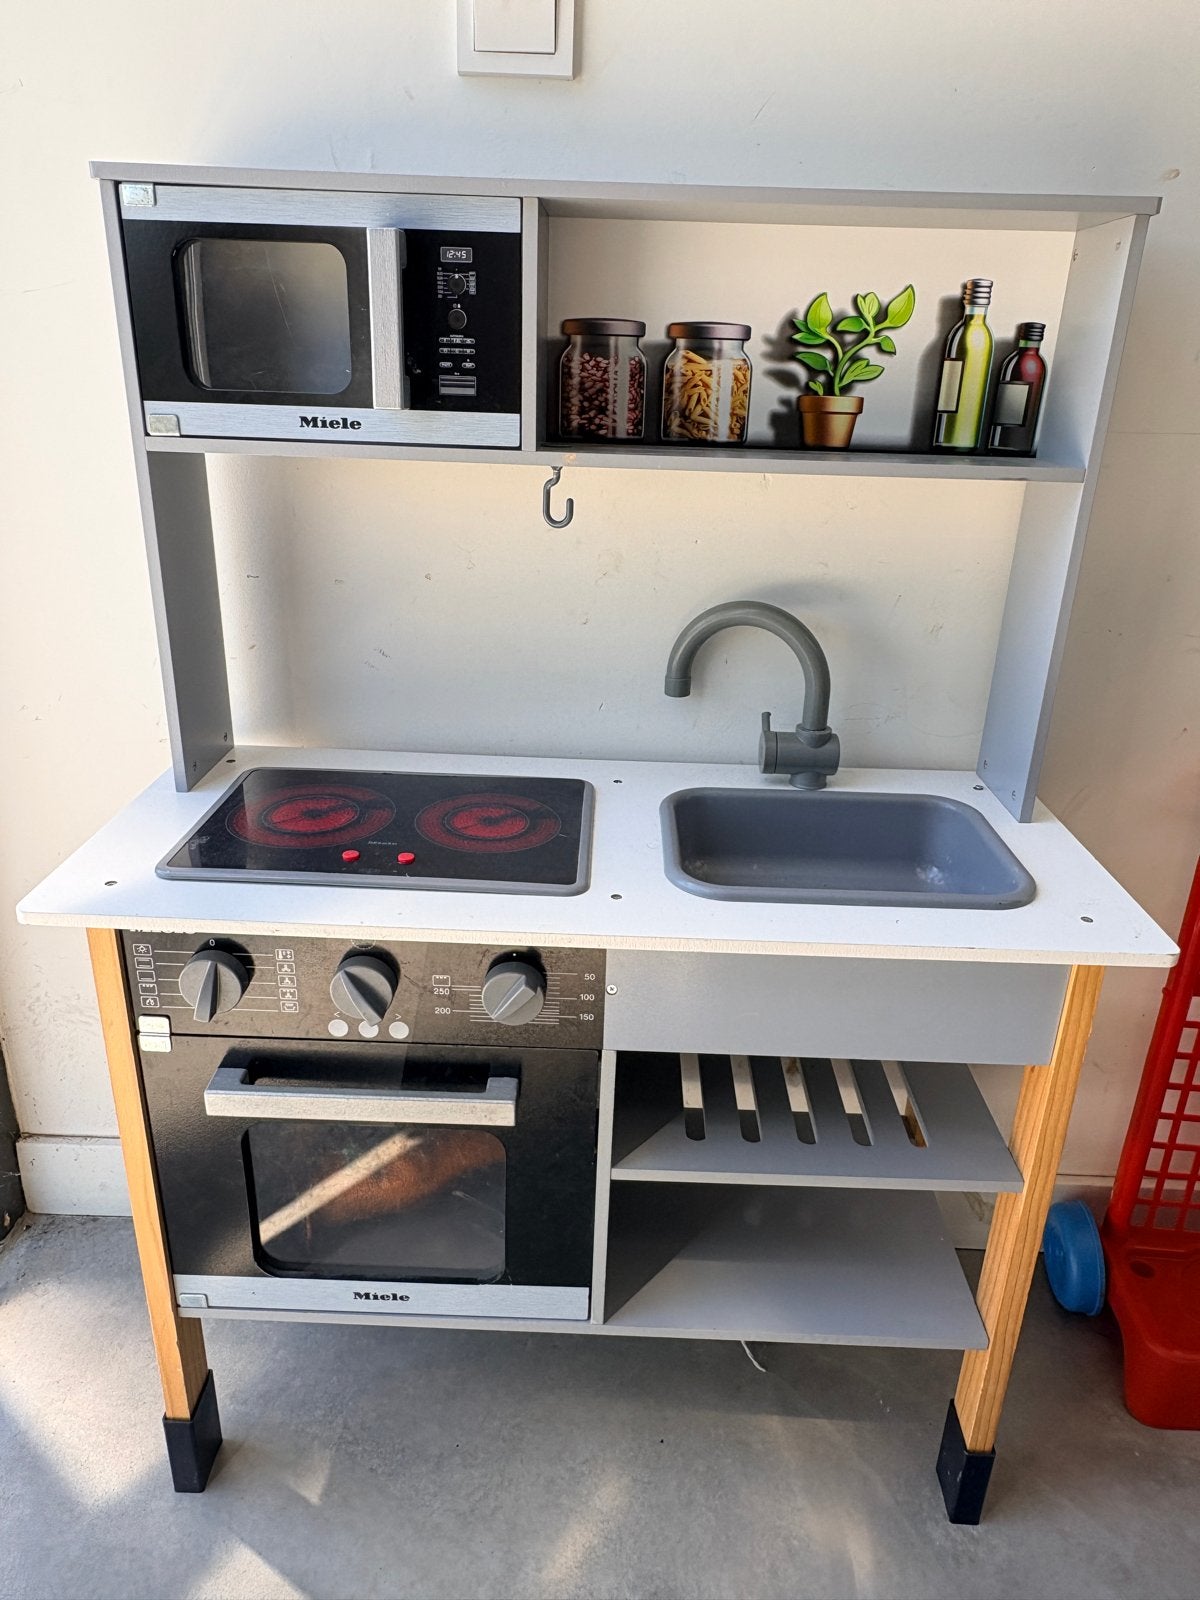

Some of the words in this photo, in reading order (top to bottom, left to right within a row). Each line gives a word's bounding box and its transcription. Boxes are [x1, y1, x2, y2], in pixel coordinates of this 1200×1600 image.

[447, 250, 467, 259] 12:45
[299, 415, 362, 430] Miele
[584, 973, 596, 981] 50
[433, 987, 450, 995] 250
[579, 993, 595, 1001] 100
[434, 1007, 451, 1015] 200
[579, 1013, 594, 1021] 150
[352, 1291, 411, 1302] Miele
